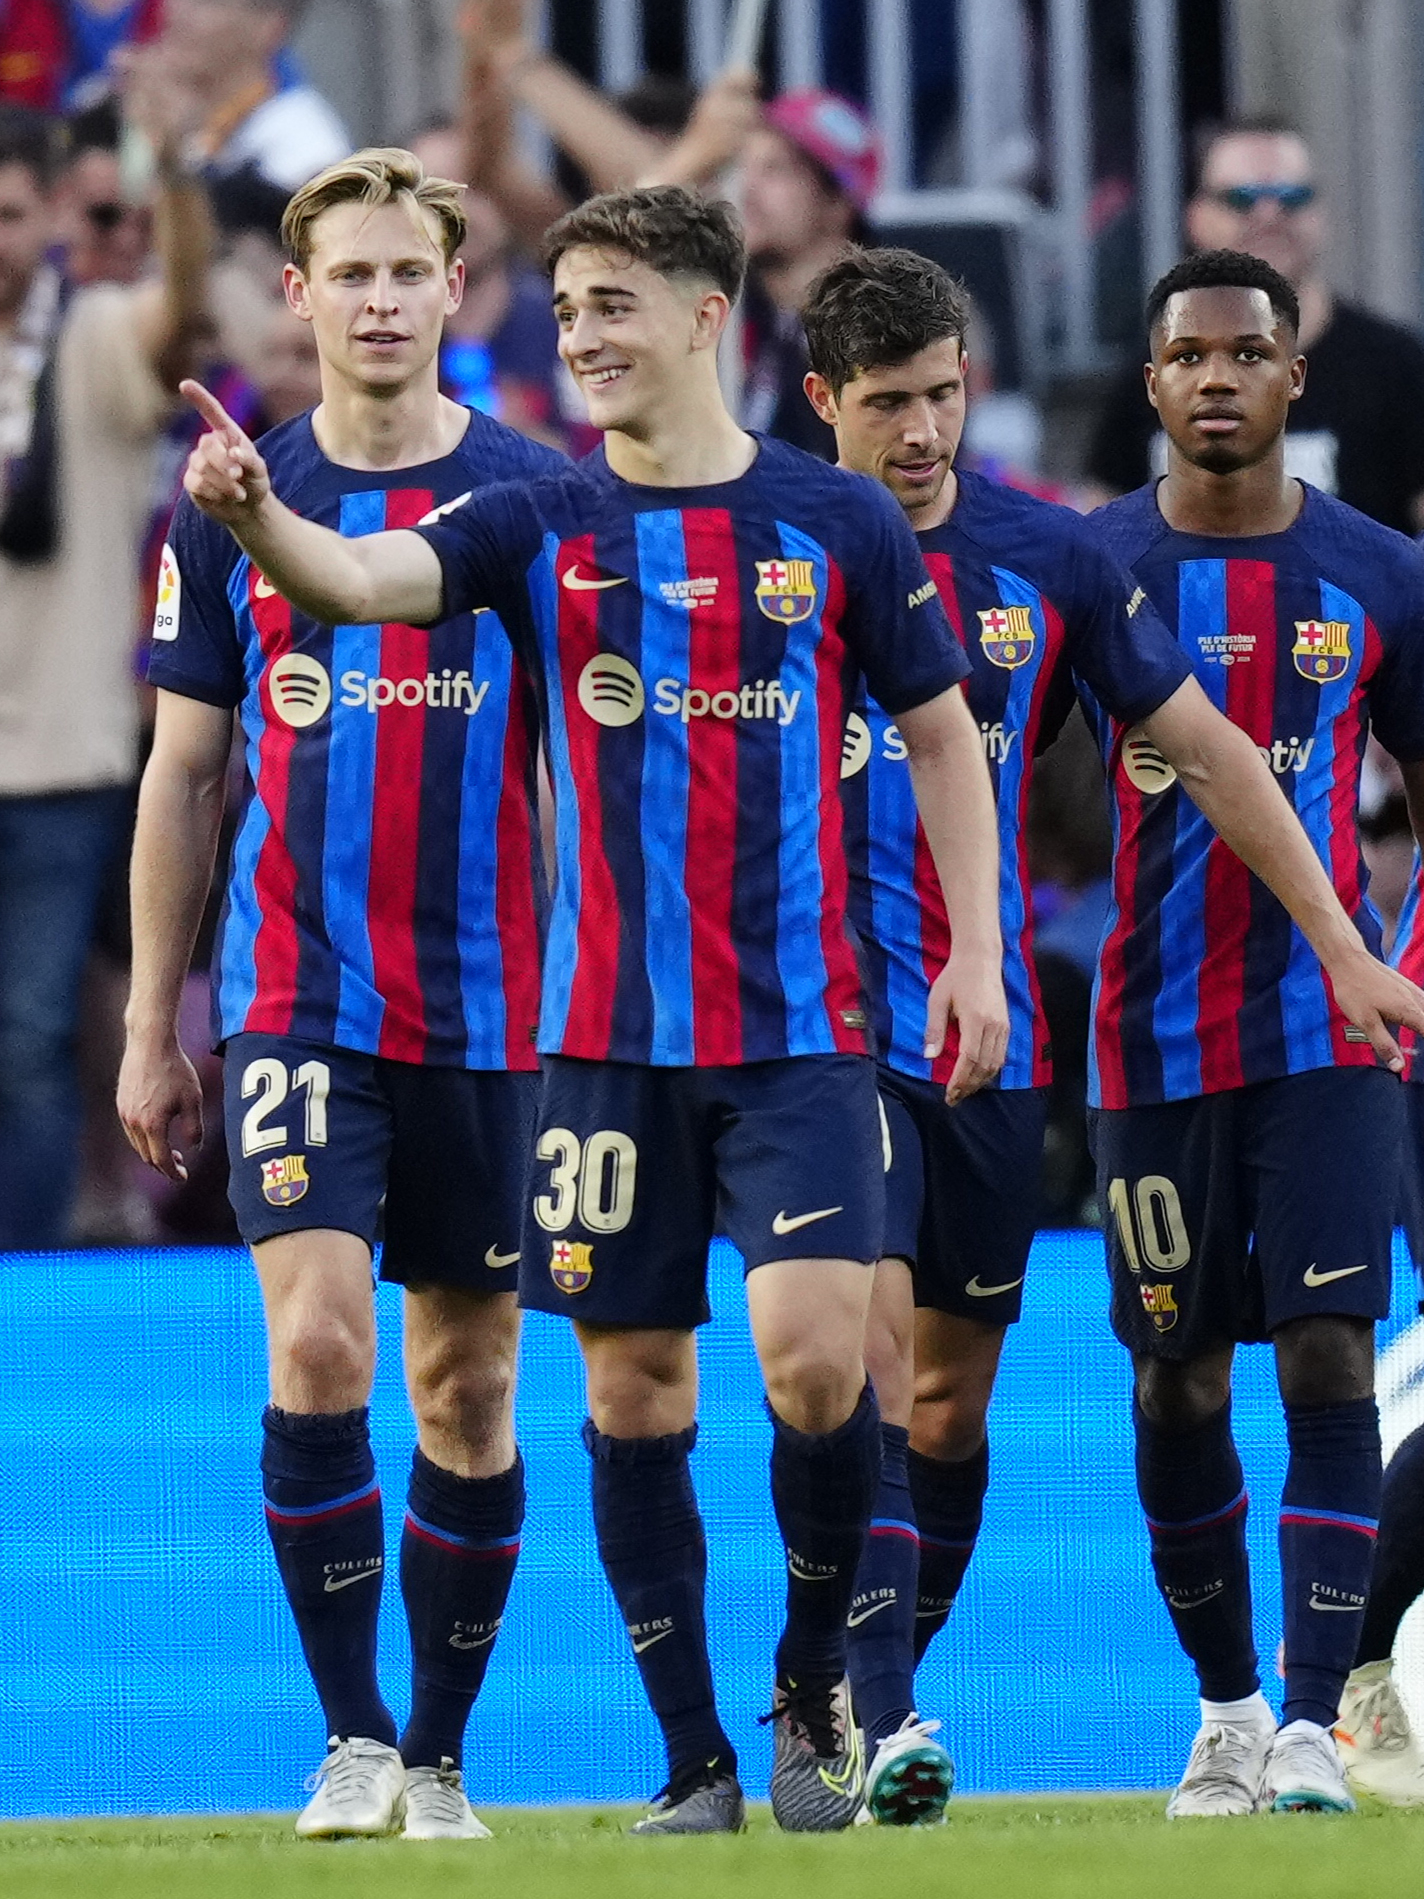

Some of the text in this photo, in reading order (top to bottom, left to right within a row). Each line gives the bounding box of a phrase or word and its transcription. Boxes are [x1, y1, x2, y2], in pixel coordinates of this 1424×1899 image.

[339, 668, 490, 715] Spotify
[653, 678, 801, 726] Spotify
[241, 1057, 331, 1159] 21
[533, 1127, 638, 1234] 30
[1107, 1174, 1191, 1274] 10
[851, 1587, 897, 1609] ULERS
[1311, 1581, 1366, 1605] CULERS
